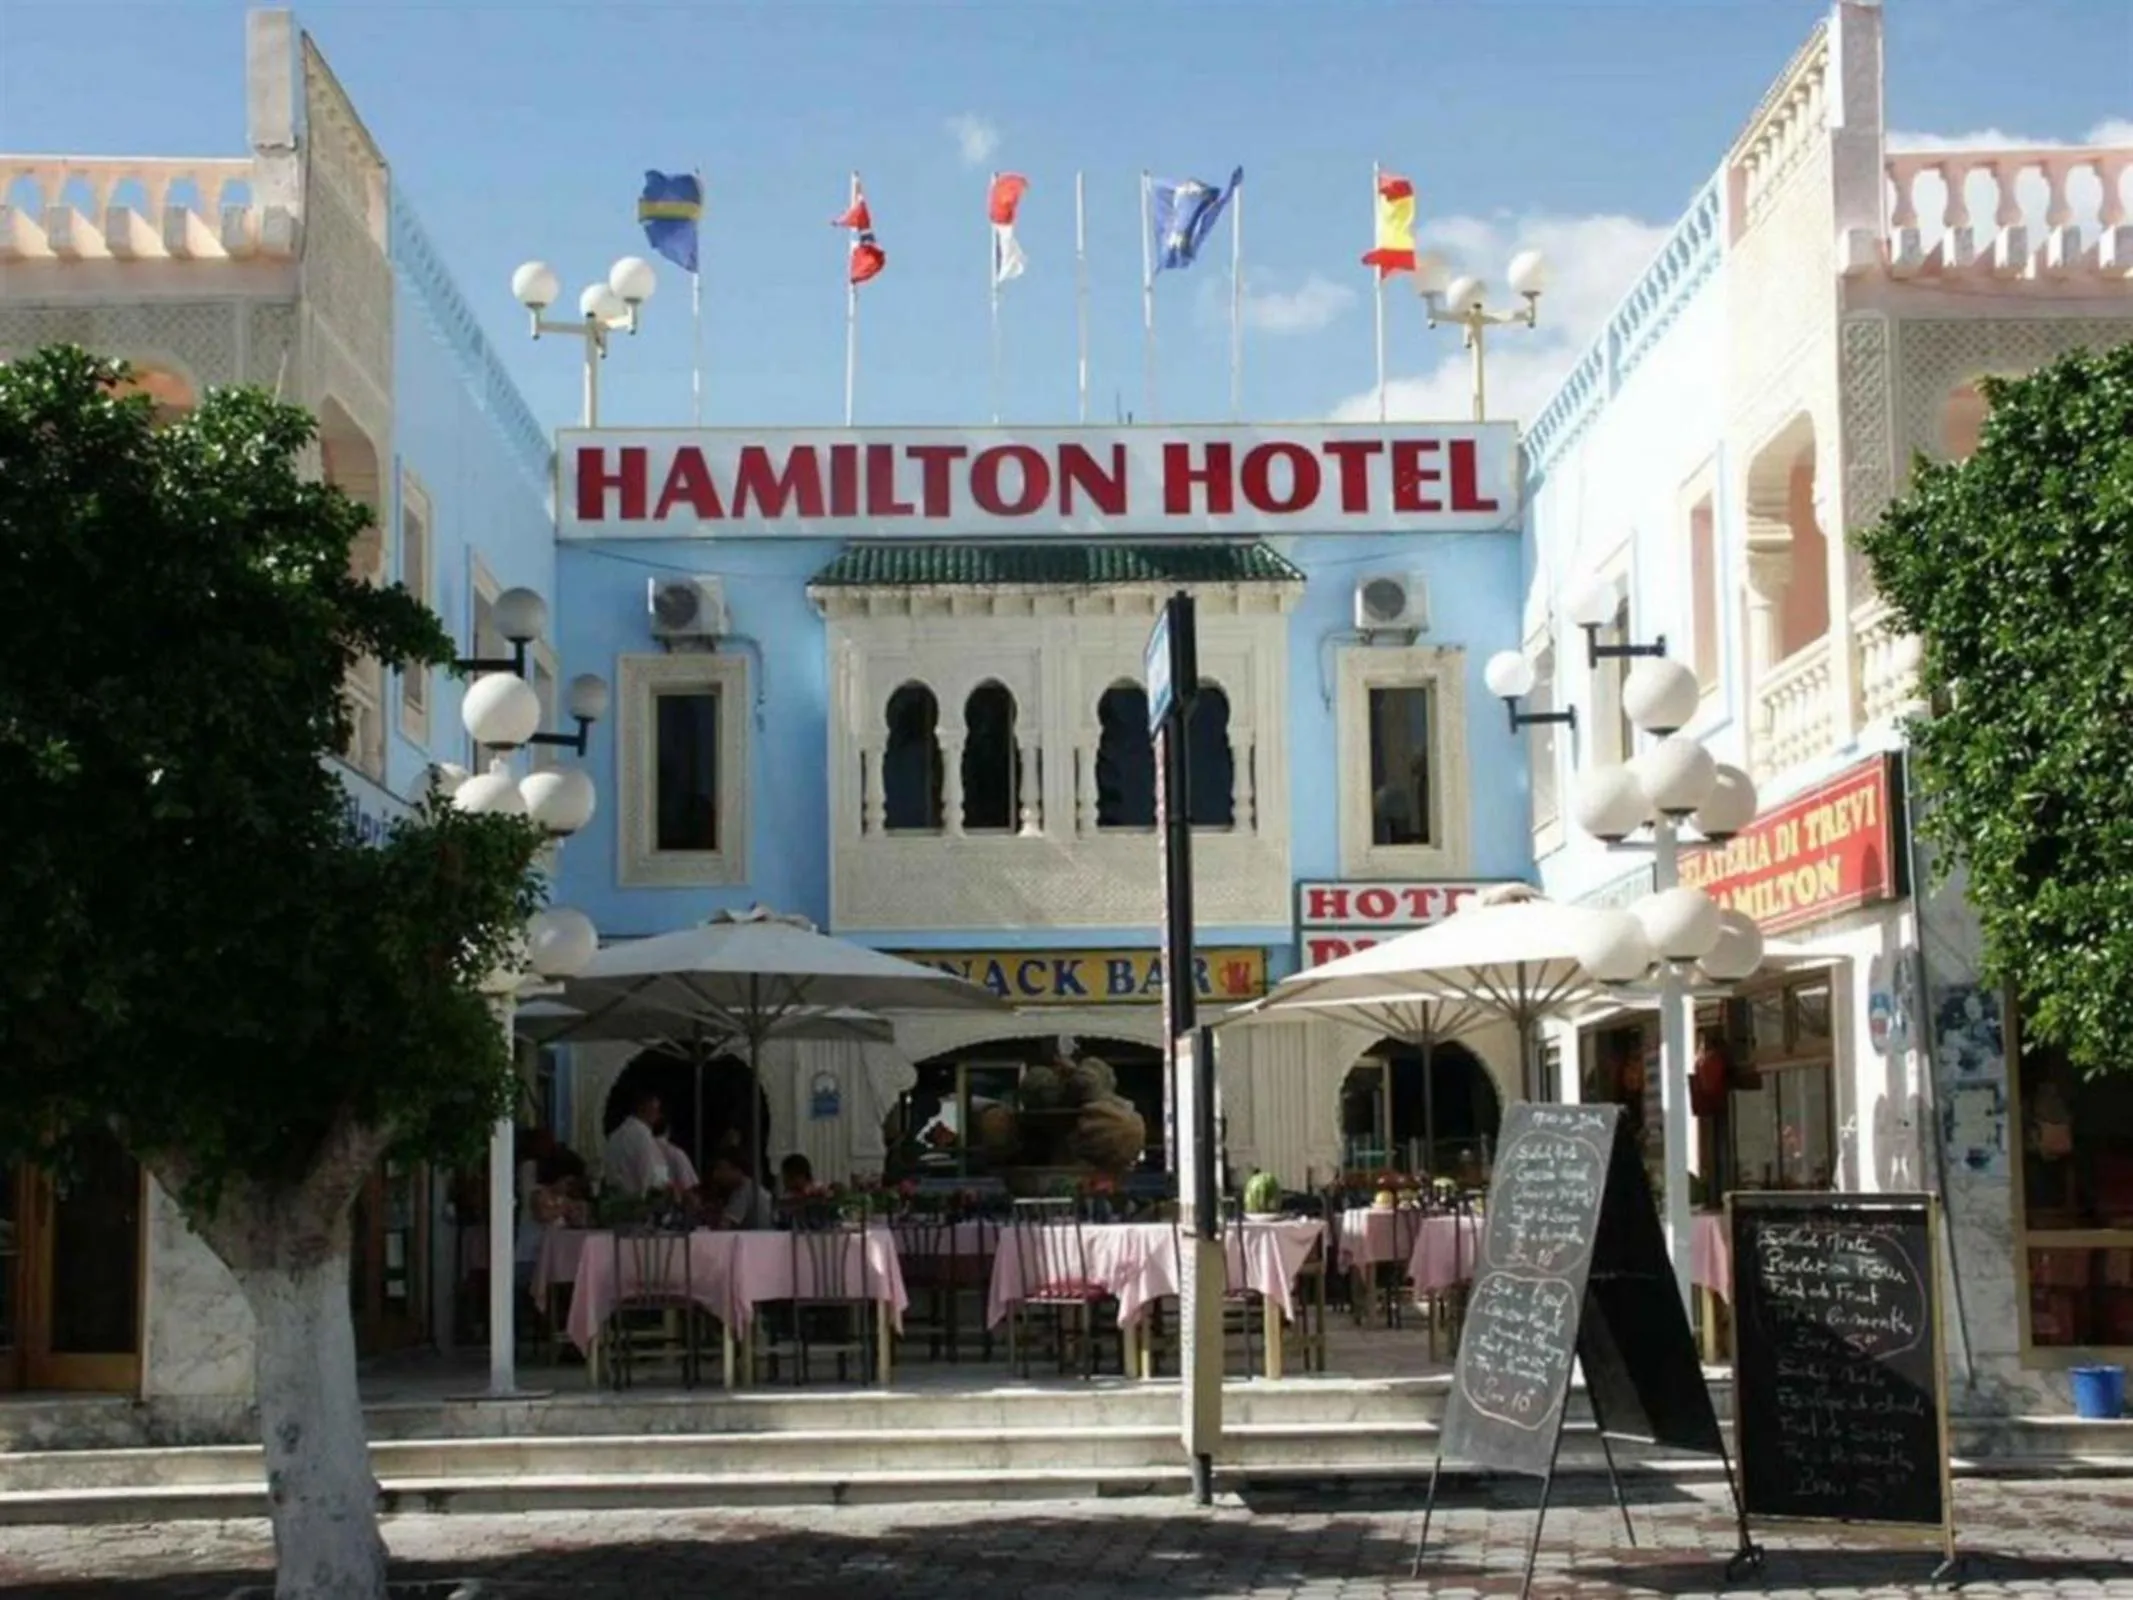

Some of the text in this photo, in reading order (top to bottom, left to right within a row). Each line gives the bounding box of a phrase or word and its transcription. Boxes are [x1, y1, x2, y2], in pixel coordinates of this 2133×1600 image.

[576, 439, 1499, 521] HAMILTON HOTEL
[1774, 818, 1801, 863] DI
[1803, 785, 1878, 850] TREVI
[1709, 855, 1842, 921] AMILTON
